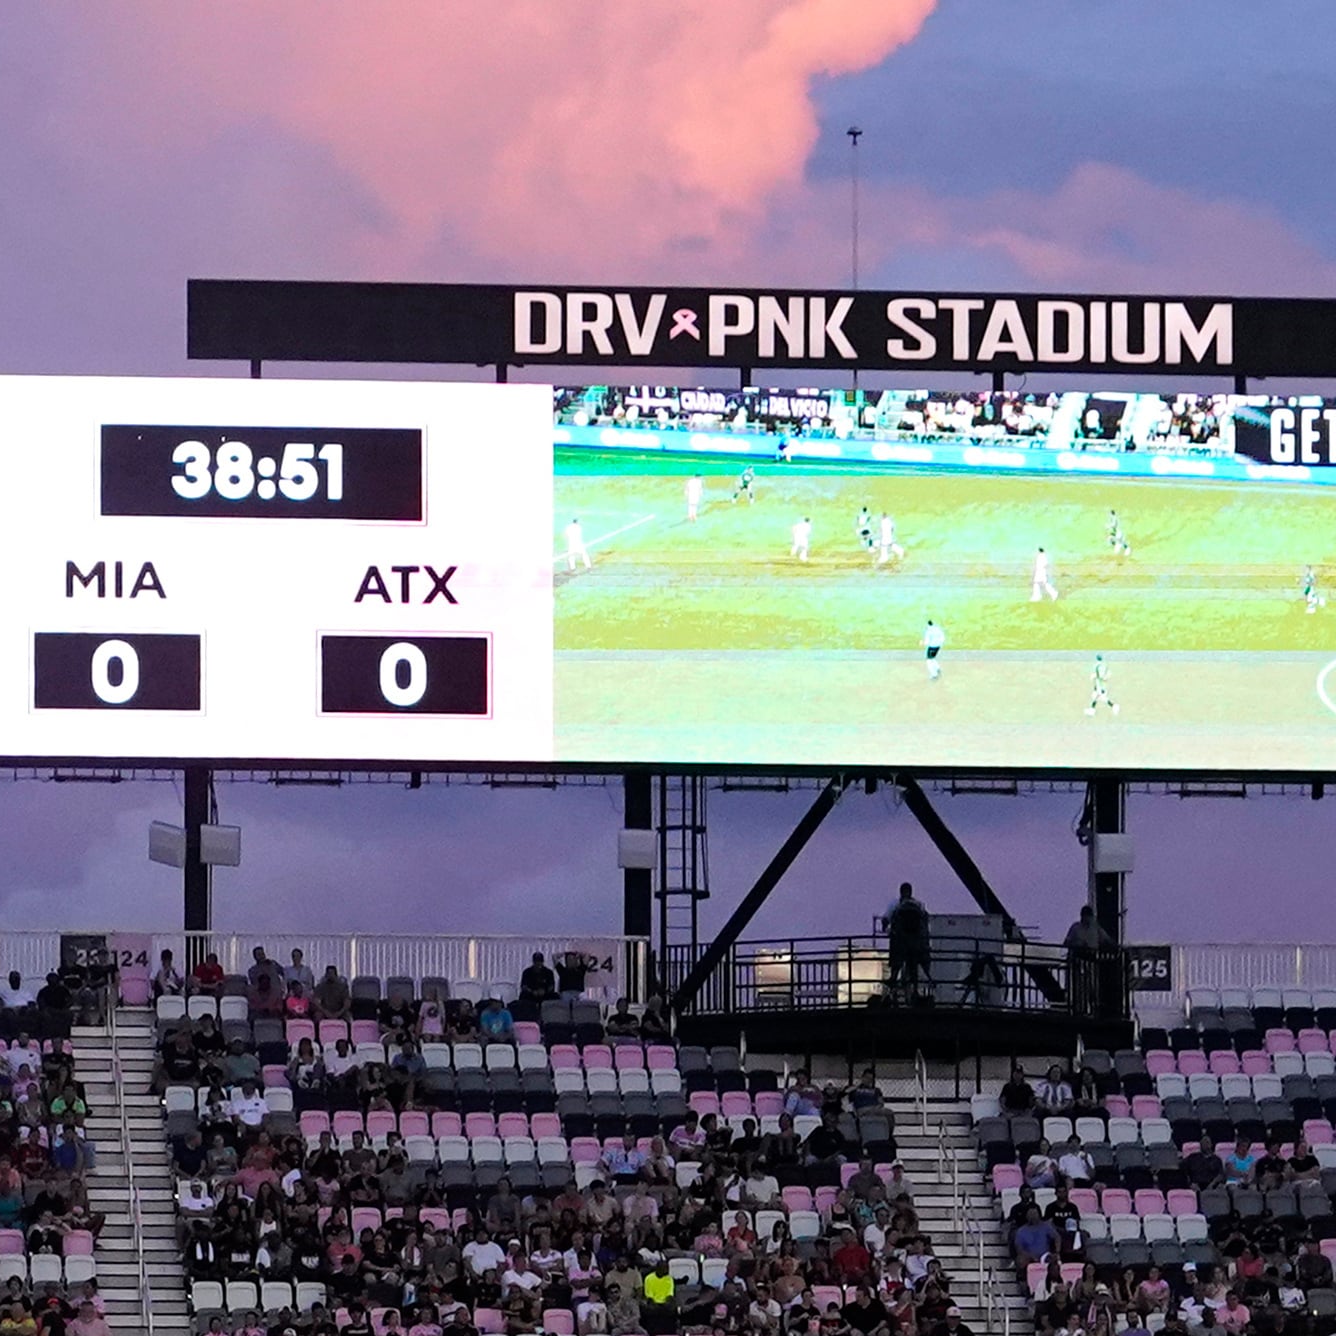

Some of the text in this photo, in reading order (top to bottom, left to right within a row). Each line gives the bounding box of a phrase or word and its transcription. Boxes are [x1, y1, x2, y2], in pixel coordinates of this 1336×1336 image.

[512, 292, 1235, 365] DRV PNK STADIUM
[170, 440, 344, 501] 38:51
[64, 560, 168, 599] MIA
[353, 565, 459, 605] ATX
[91, 639, 140, 704] 0
[378, 641, 428, 707] 0
[586, 955, 614, 973] 24
[1129, 959, 1168, 978] 125
